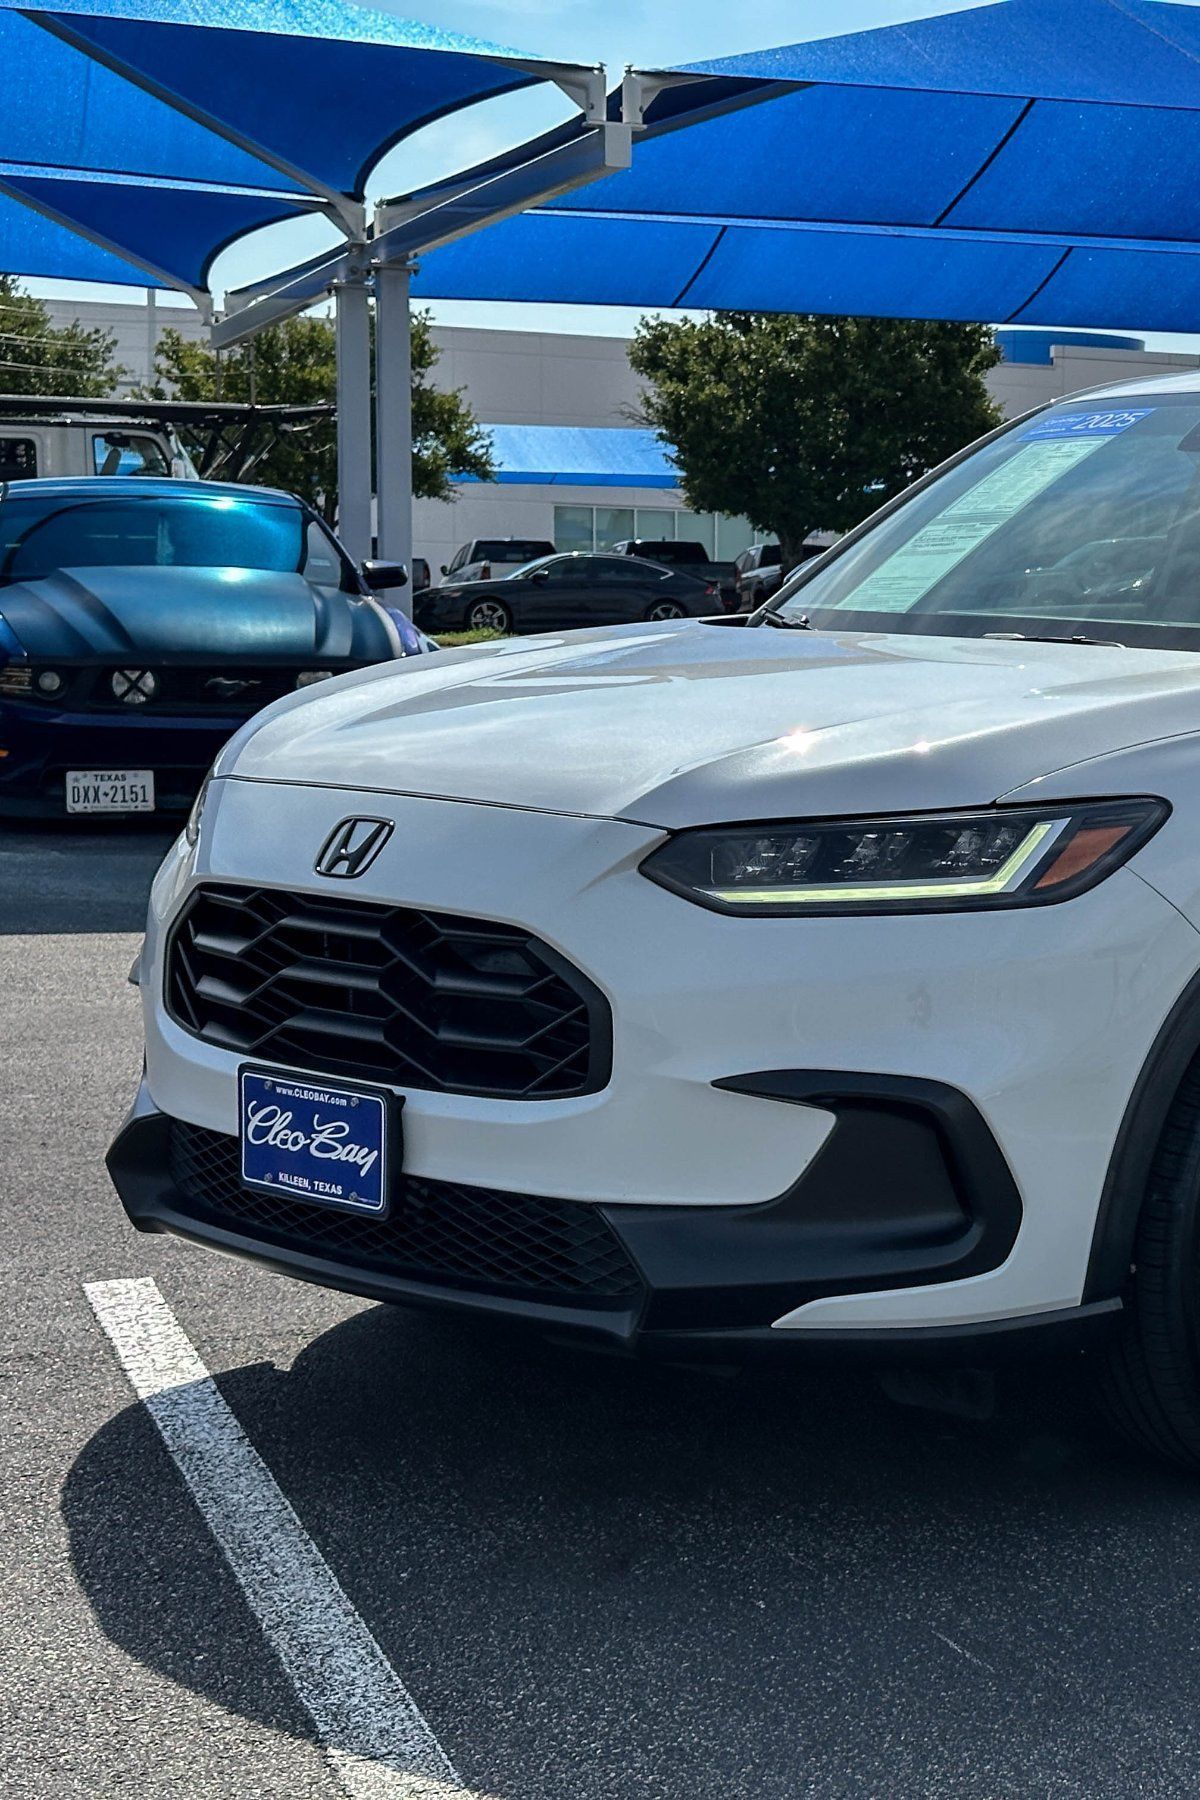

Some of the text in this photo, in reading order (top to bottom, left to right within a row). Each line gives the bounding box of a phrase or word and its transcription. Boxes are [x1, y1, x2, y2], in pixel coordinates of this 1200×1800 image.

[1071, 412, 1145, 430] 2025
[94, 774, 127, 782] TEXAS
[275, 1086, 347, 1106] www.CLEOBAY.com
[248, 1100, 378, 1177] Cleo Bay
[278, 1171, 343, 1196] KILLEEN, TEXAS
